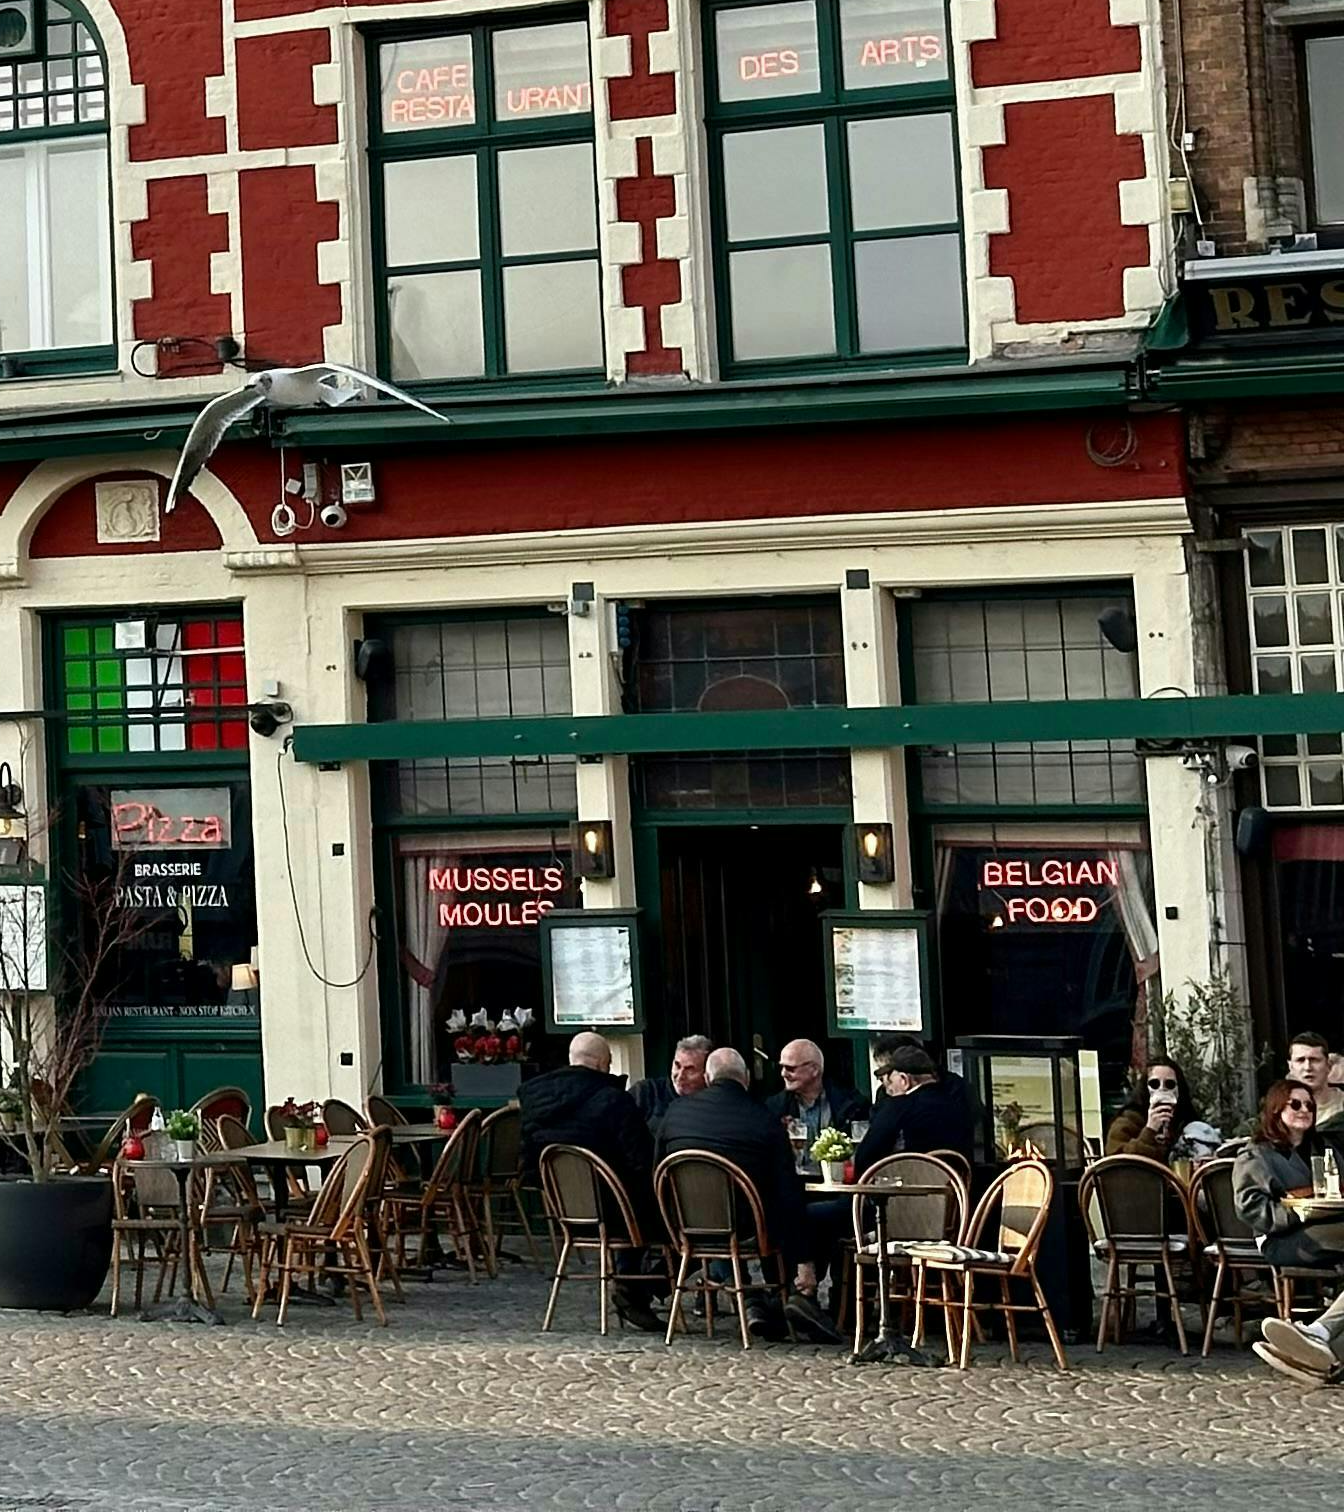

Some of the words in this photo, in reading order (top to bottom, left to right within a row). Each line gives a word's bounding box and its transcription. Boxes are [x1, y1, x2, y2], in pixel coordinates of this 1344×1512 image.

[739, 49, 800, 81] DES
[860, 35, 942, 66] ARTS
[396, 64, 470, 94] CAFE
[112, 803, 223, 843] Pizza
[134, 863, 202, 877] BRASSERIE
[428, 867, 563, 892] MUSSELS
[983, 859, 1119, 887] BELGIAN
[115, 885, 163, 908] PASTA
[166, 885, 178, 908] &
[182, 884, 230, 908] PIZZA
[1008, 896, 1099, 923] FOOD
[124, 1006, 175, 1018] RESTAURANT
